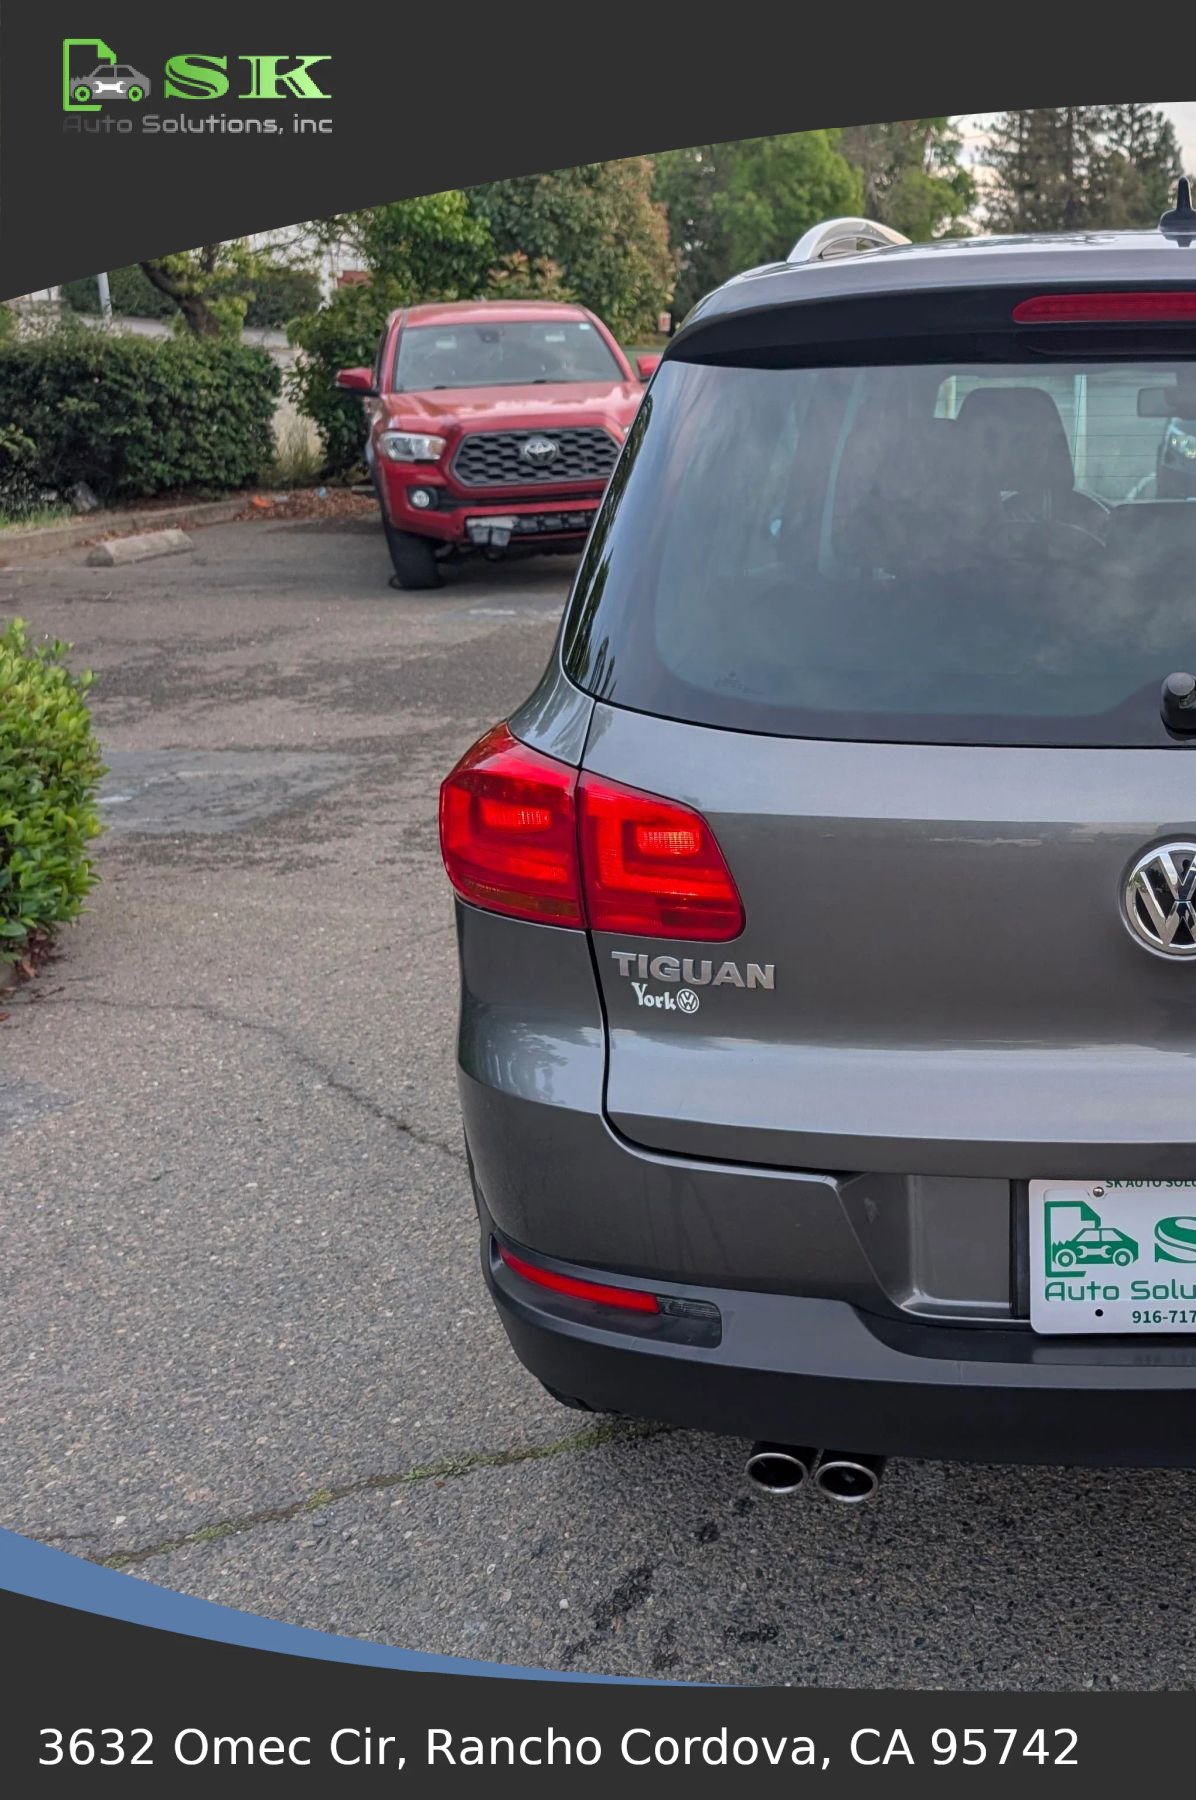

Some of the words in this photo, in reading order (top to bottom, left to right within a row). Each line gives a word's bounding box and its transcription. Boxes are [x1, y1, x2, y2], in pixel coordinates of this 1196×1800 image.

[611, 951, 775, 990] TIGUAN
[631, 982, 677, 1011] York
[1125, 1179, 1162, 1188] AUTO
[1045, 1280, 1120, 1302] Auto
